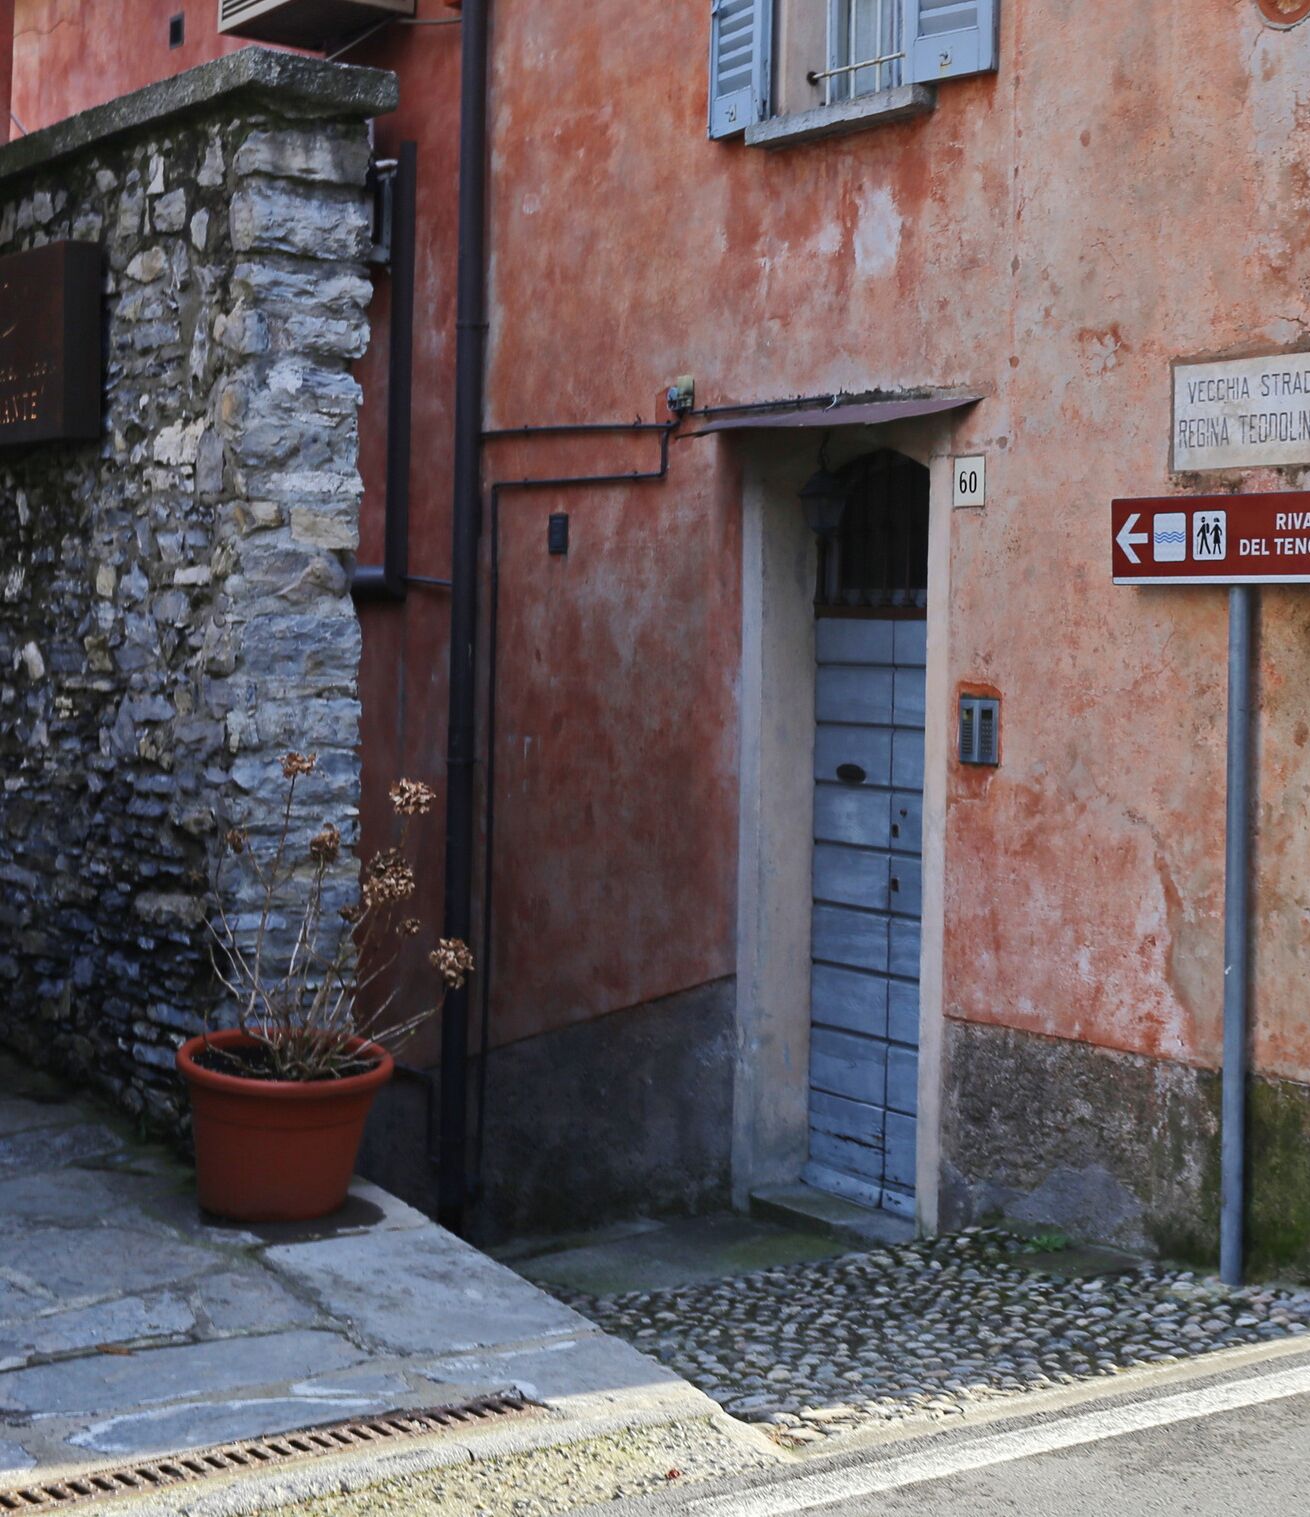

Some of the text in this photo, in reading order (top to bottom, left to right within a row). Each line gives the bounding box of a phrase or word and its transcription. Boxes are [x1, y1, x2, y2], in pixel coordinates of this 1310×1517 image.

[1188, 377, 1250, 404] VECCHIA
[1179, 417, 1230, 448] REGINA
[960, 471, 977, 493] 60
[1239, 539, 1270, 556] DEL
